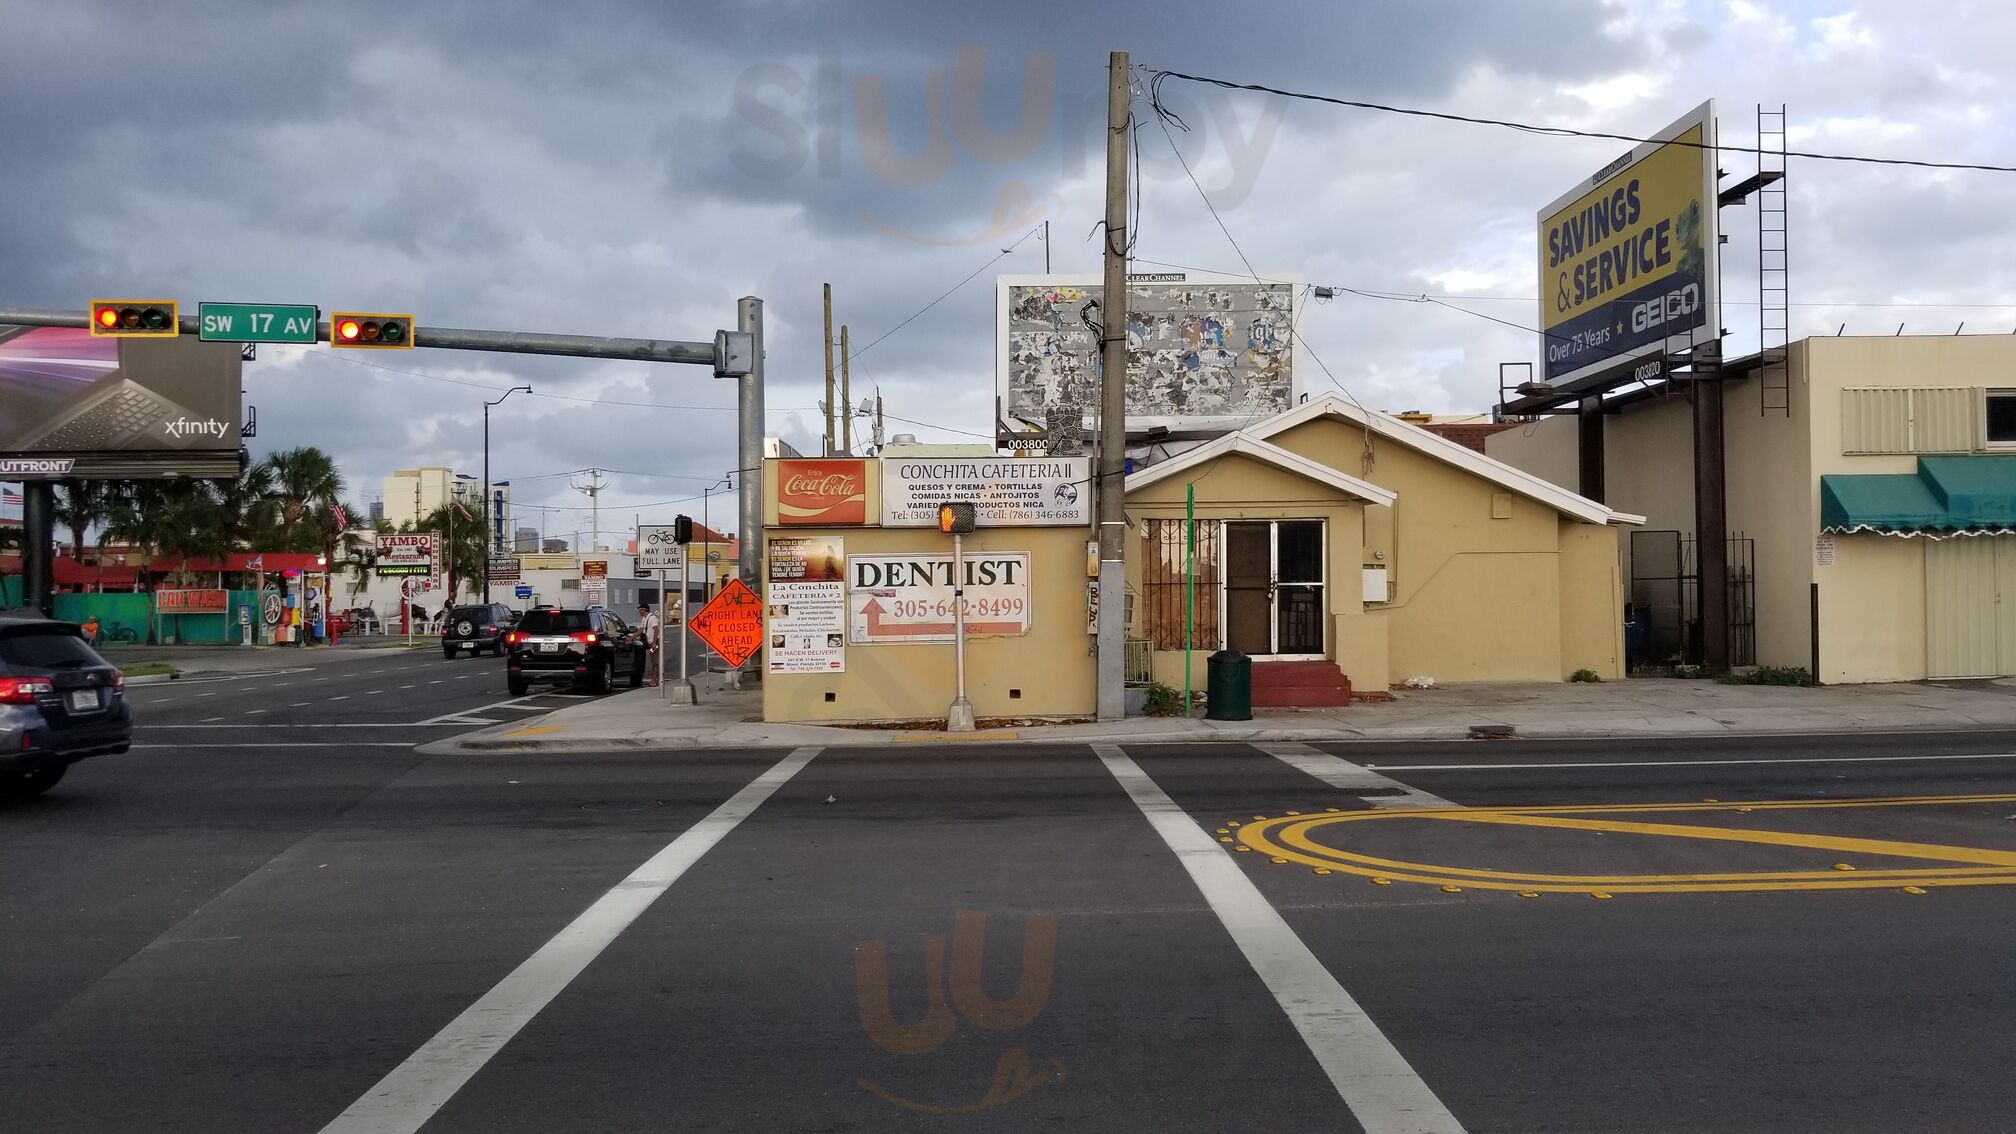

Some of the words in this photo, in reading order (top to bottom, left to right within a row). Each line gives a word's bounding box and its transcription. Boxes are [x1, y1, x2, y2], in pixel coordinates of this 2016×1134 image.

[1549, 179, 1640, 267] SAVINGS
[1557, 270, 1571, 312] &
[1574, 218, 1671, 305] SERVICE
[1632, 282, 1699, 333] GEICO
[204, 315, 232, 333] SW
[250, 313, 273, 332] 17
[283, 317, 311, 334] AV
[1549, 341, 1571, 363] Over
[1572, 332, 1583, 355] 75
[1584, 326, 1610, 347] Years
[164, 417, 229, 438] xfinity
[0, 461, 70, 471] UTFRONT
[808, 469, 822, 477] Enjoy
[900, 464, 978, 479] CONCHITA
[982, 463, 1062, 478] CAFETERIA
[892, 511, 908, 520] Tel:
[910, 511, 934, 520] (305)
[986, 510, 1007, 519] Cell:
[1009, 510, 1033, 520] (786)
[1035, 510, 1079, 519] 346-6883
[380, 537, 428, 546] YAMBO
[855, 560, 1022, 588] DENTIST
[708, 610, 736, 620] RIGHT
[894, 598, 1023, 618] 305-642-8499
[718, 623, 755, 632] CLOSED
[721, 636, 752, 645] AHEAD
